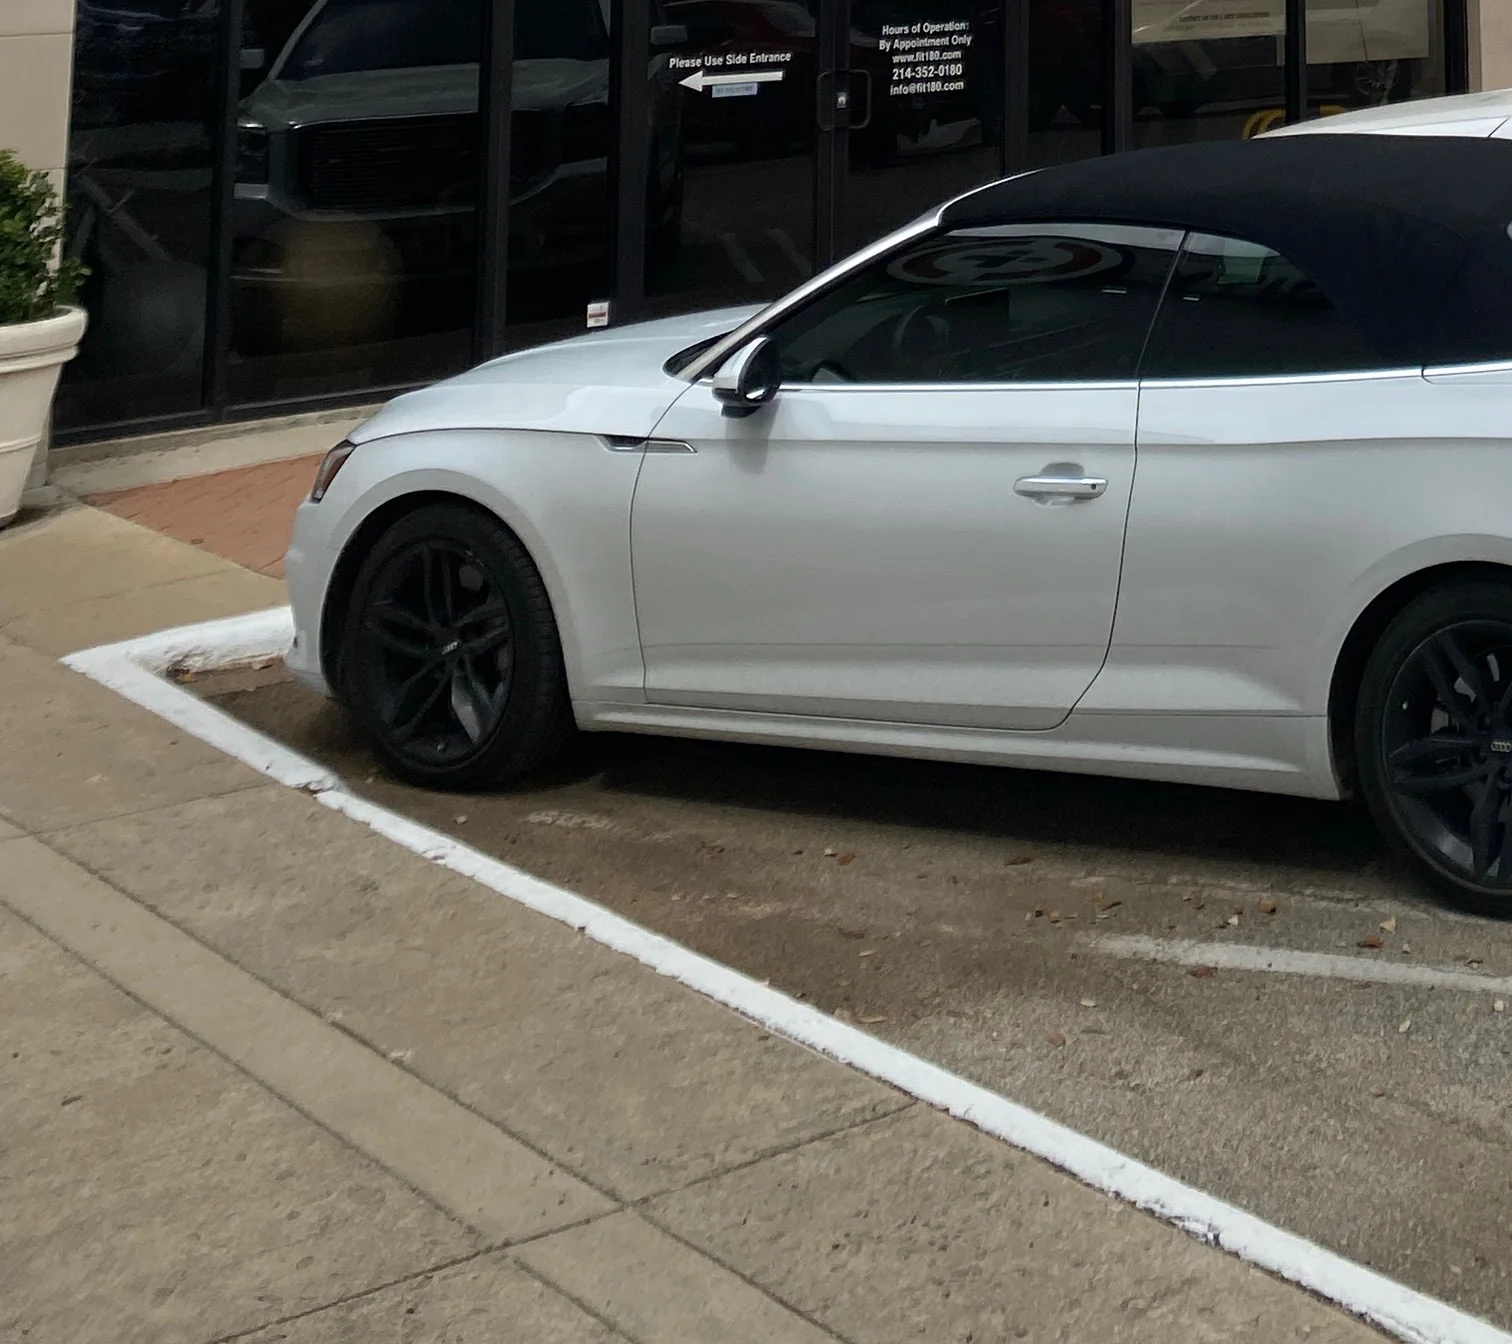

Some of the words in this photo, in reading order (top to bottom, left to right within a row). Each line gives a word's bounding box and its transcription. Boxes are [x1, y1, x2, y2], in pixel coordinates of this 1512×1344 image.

[882, 24, 909, 35] Hours
[911, 23, 921, 33] of
[923, 21, 970, 34] Operation:
[879, 39, 891, 52] By
[893, 37, 949, 50] Appointment
[951, 34, 972, 46] Only
[669, 57, 702, 68] Please
[704, 56, 723, 66] Use
[726, 54, 747, 65] Side
[749, 52, 792, 64] Entrance
[892, 51, 962, 63] www.fit180.com
[892, 64, 963, 80] 214-352-0180
[890, 81, 964, 96] info@fit180.com
